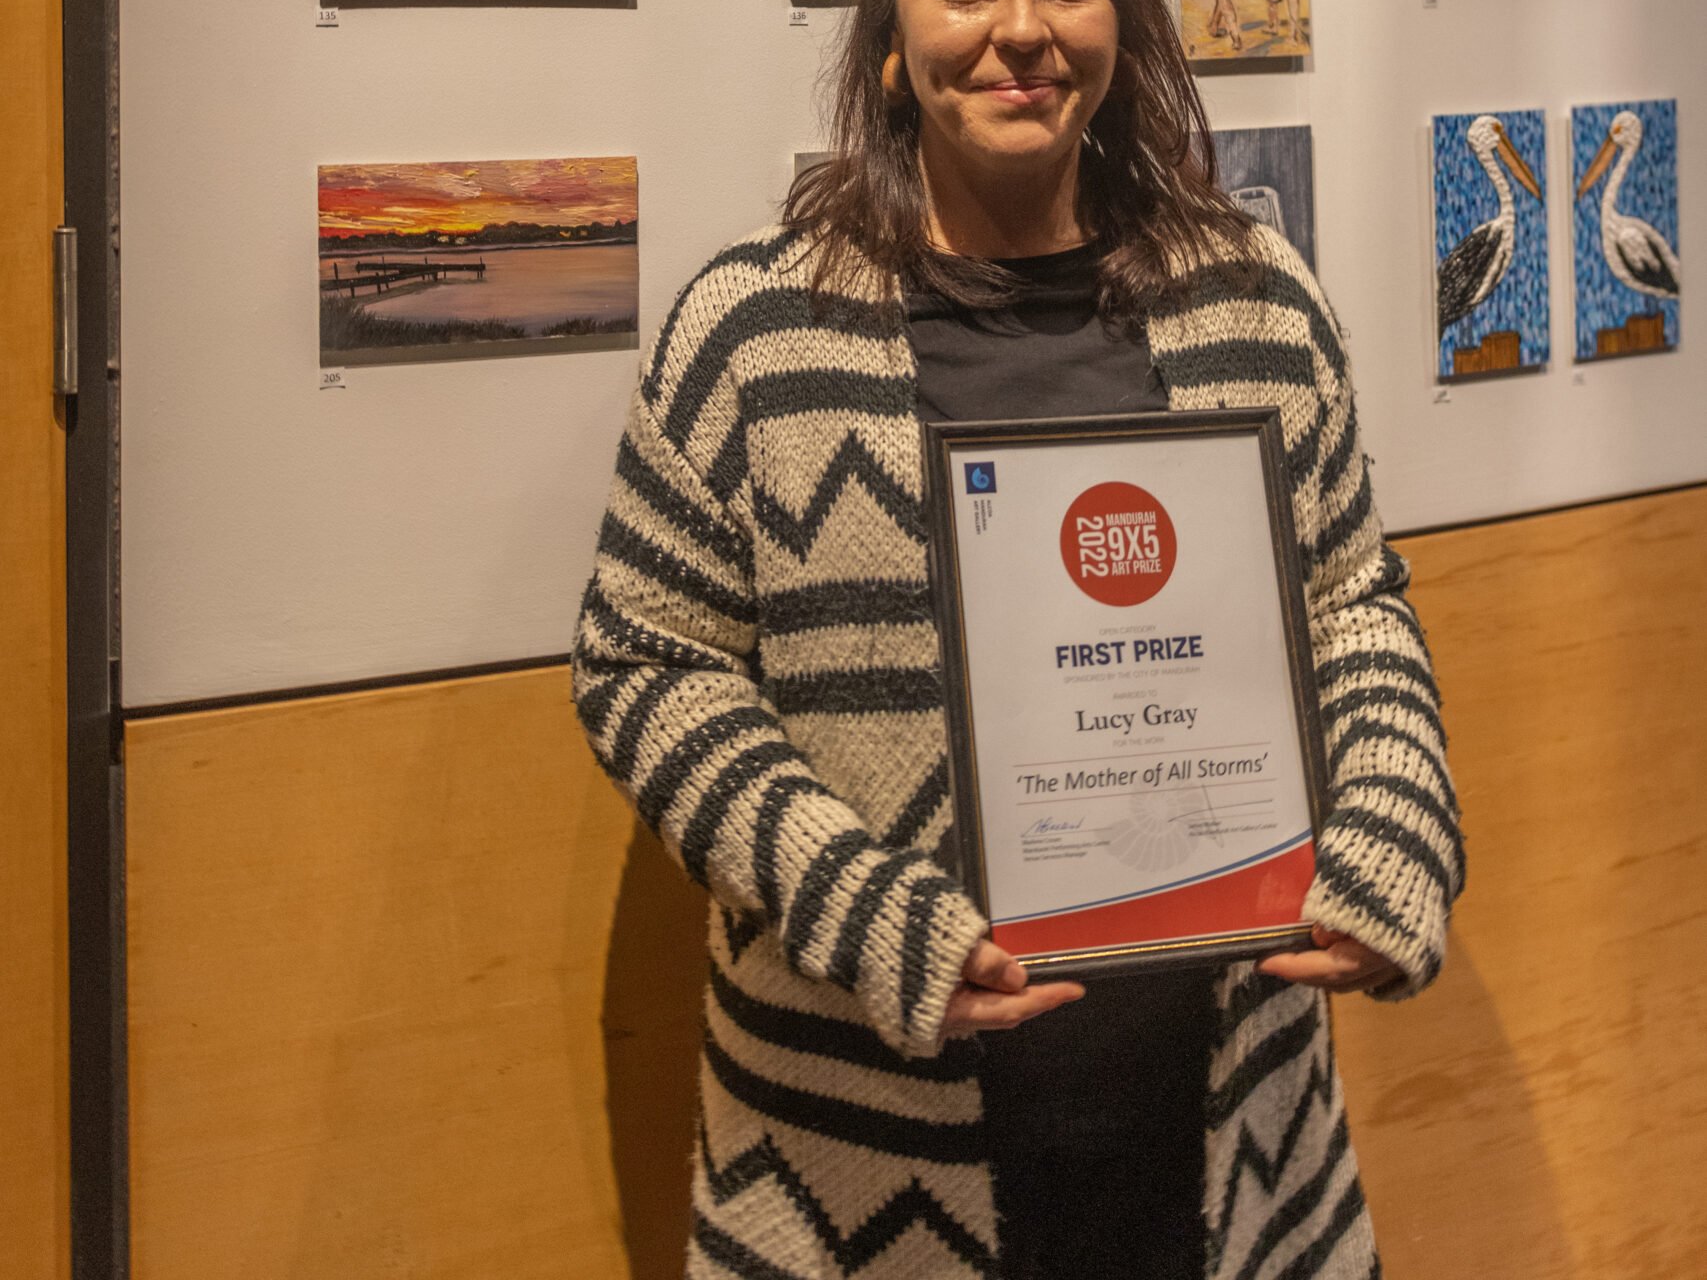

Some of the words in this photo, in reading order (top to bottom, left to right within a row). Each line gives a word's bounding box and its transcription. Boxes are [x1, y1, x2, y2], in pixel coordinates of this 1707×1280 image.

[320, 11, 337, 20] 135
[323, 373, 341, 383] 205
[1106, 512, 1157, 526] MANDURAH
[1076, 516, 1109, 578] 2022
[1107, 524, 1160, 561] 9X5
[1112, 561, 1131, 576] ART
[1133, 559, 1162, 575] PRIZE
[1055, 641, 1126, 669] FIRST
[1134, 635, 1204, 662] PRIZE
[1075, 709, 1135, 735] Lucy
[1143, 703, 1198, 730] Gray
[1065, 767, 1138, 791] Mother
[1143, 762, 1164, 787] of
[1167, 760, 1192, 781] All
